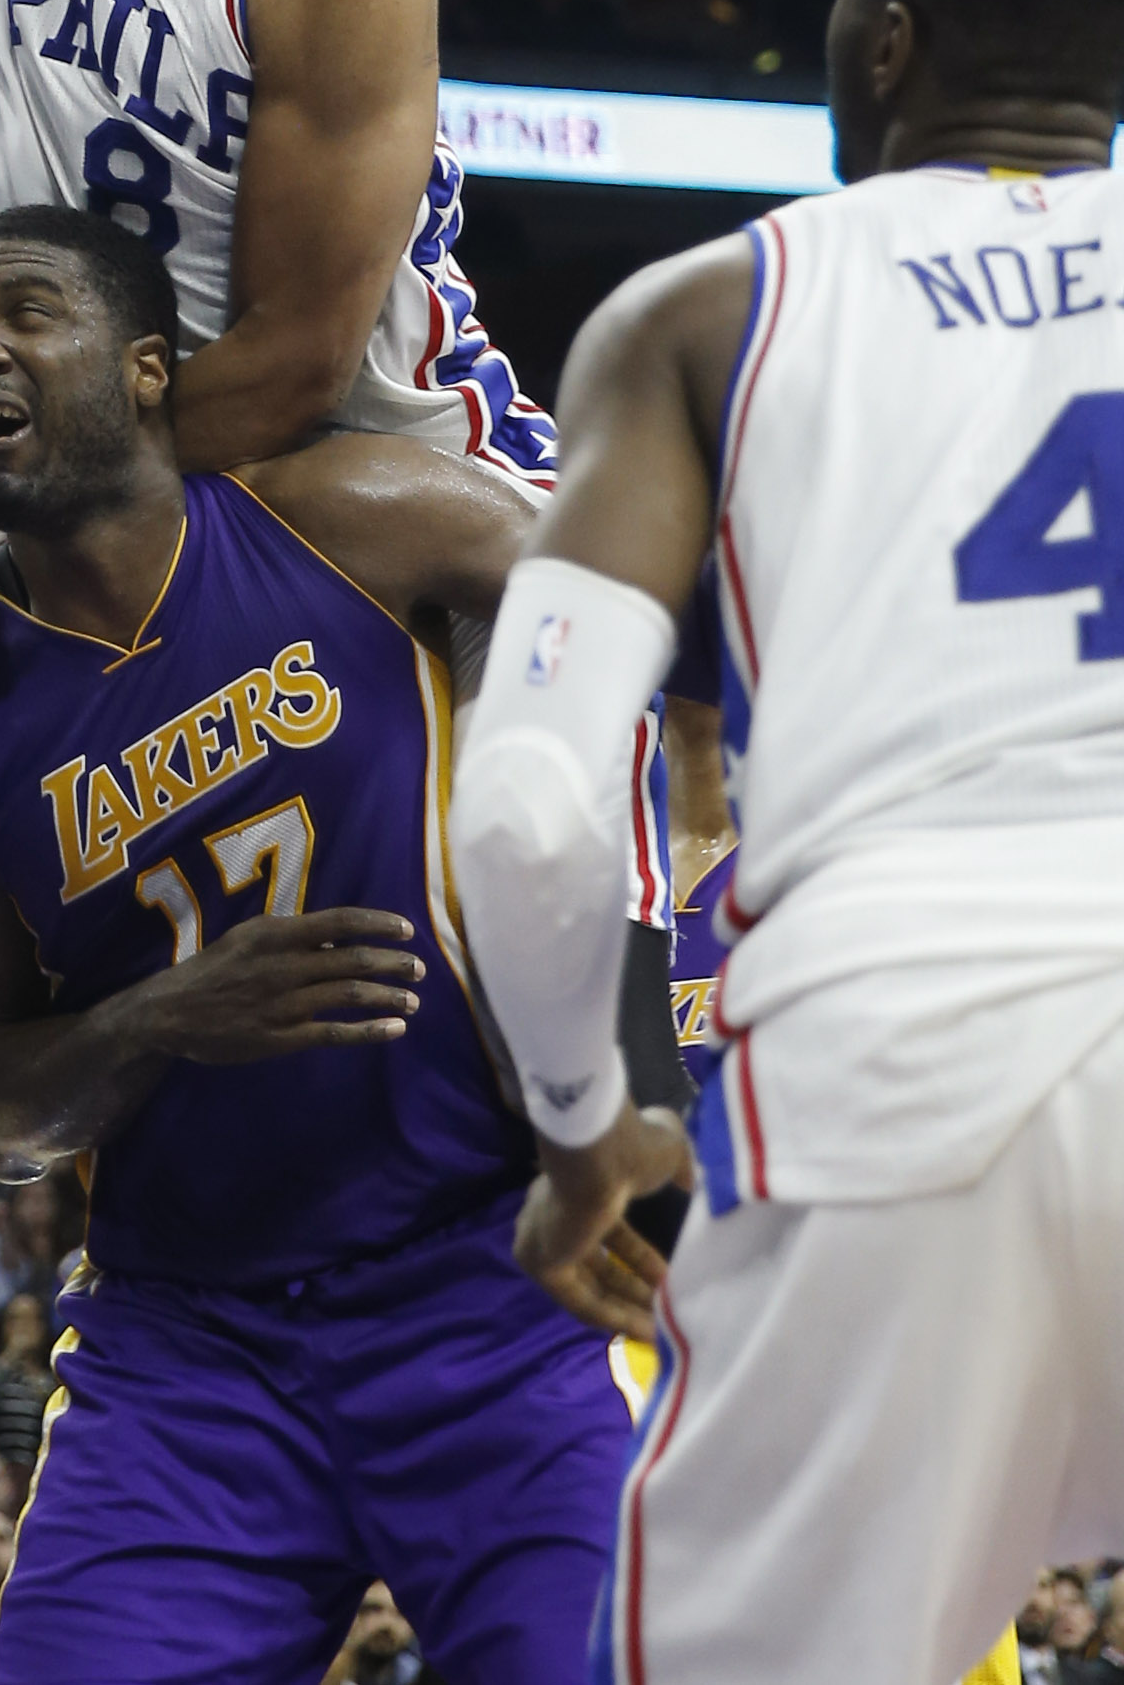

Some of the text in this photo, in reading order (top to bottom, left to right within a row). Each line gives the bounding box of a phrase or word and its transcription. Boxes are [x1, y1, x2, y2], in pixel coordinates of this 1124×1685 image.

[84, 118, 179, 254] 8
[898, 239, 1124, 331] NOE
[953, 390, 1124, 663] 4
[41, 639, 342, 905] LAKERS
[135, 794, 316, 965] 17
